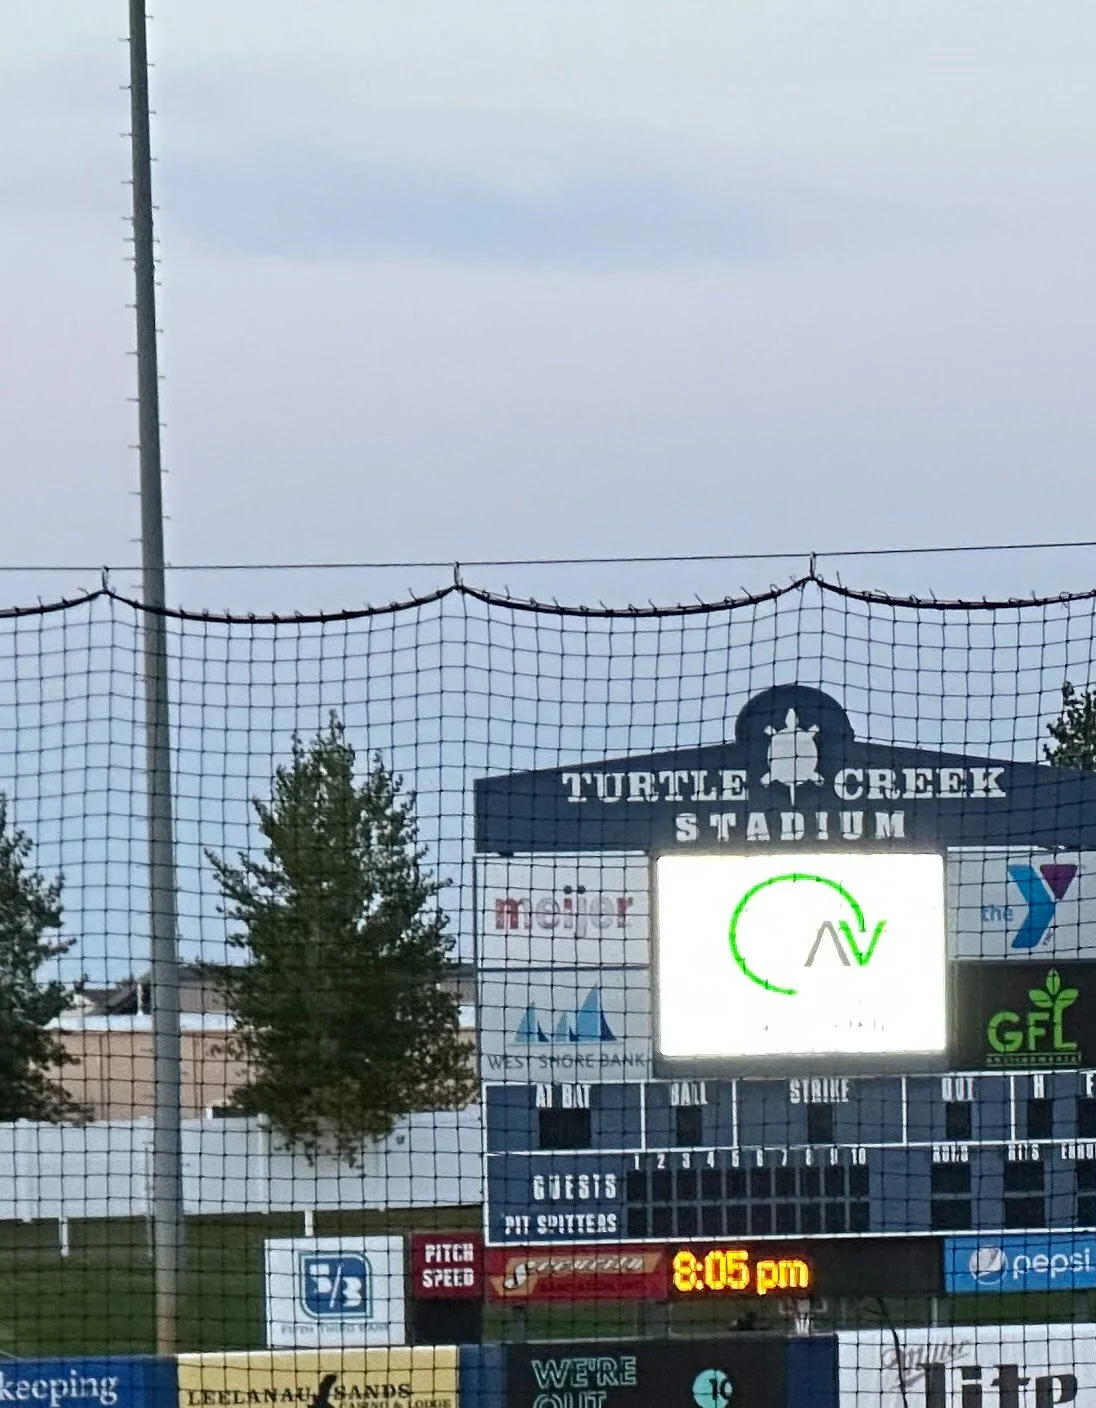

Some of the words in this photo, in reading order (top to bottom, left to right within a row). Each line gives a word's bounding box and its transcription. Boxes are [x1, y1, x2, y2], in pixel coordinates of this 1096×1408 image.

[562, 770, 749, 803] TURTLE
[833, 767, 1007, 799] CREEK
[675, 810, 906, 843] STADIUM
[495, 885, 633, 938] meijer
[981, 904, 1014, 922] the
[987, 1003, 1078, 1052] GFL
[487, 1055, 532, 1070] WEST
[539, 1053, 597, 1070] SHORE
[600, 1053, 646, 1069] BANK
[562, 1084, 591, 1109] BAT
[671, 1081, 708, 1107] BALL
[790, 1078, 849, 1104] STRIKE
[941, 1077, 975, 1102] OUT
[1033, 1074, 1045, 1099] H
[634, 1154, 641, 1170] 1
[657, 1153, 666, 1169] 2
[682, 1152, 691, 1168] 3
[707, 1151, 715, 1169] 4
[852, 1148, 866, 1165] 10
[533, 1173, 617, 1200] GUESTS
[505, 1215, 530, 1235] PIT
[537, 1213, 617, 1234] SPITTERS
[425, 1243, 474, 1263] PITCH
[1012, 1248, 1091, 1279] pepsi
[422, 1267, 475, 1288] SPEED
[672, 1249, 750, 1292] 8:05
[756, 1259, 809, 1295] pm
[531, 1356, 638, 1389] WE'RE
[187, 1386, 312, 1407] LEELANAU
[333, 1383, 412, 1400] SANDS
